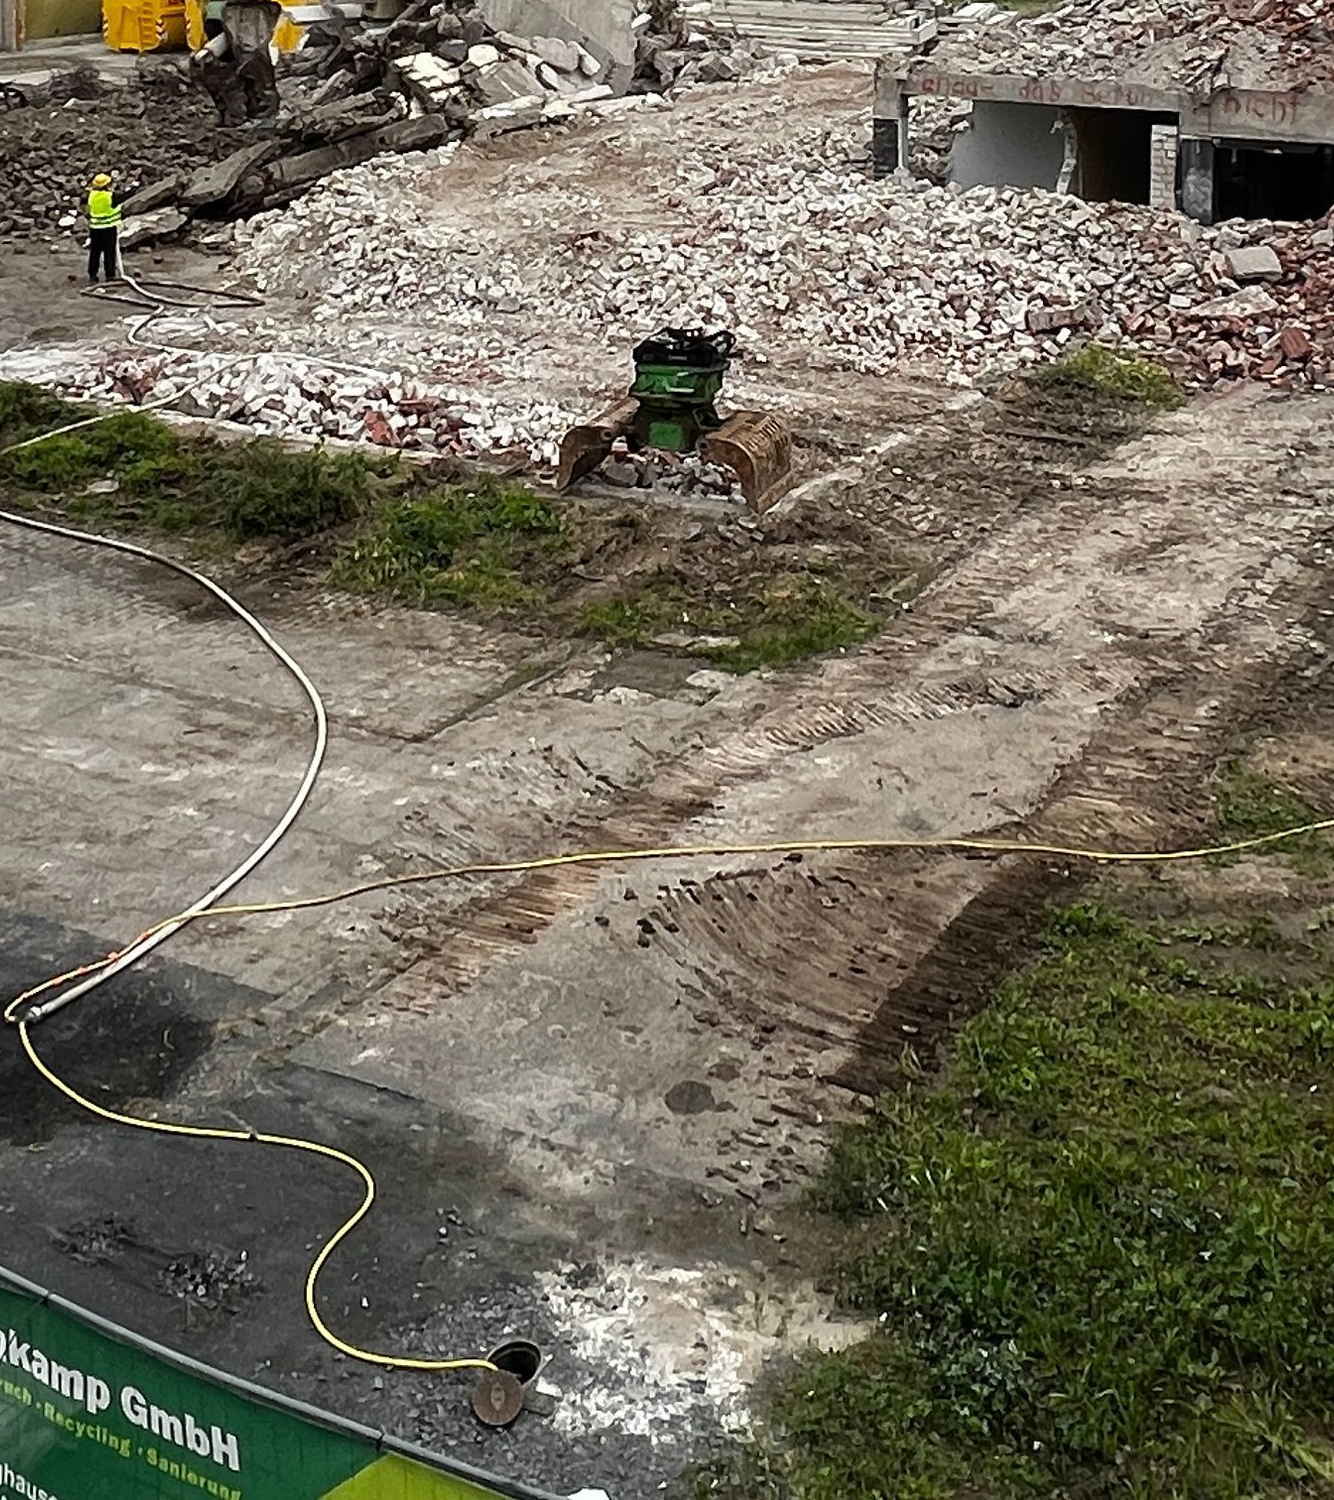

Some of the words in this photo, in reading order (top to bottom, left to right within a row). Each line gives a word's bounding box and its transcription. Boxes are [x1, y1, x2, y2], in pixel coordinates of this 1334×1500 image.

[44, 1402, 131, 1458] Recycling
[146, 1446, 243, 1500] Sanierung
[120, 1386, 242, 1472] GmbH
